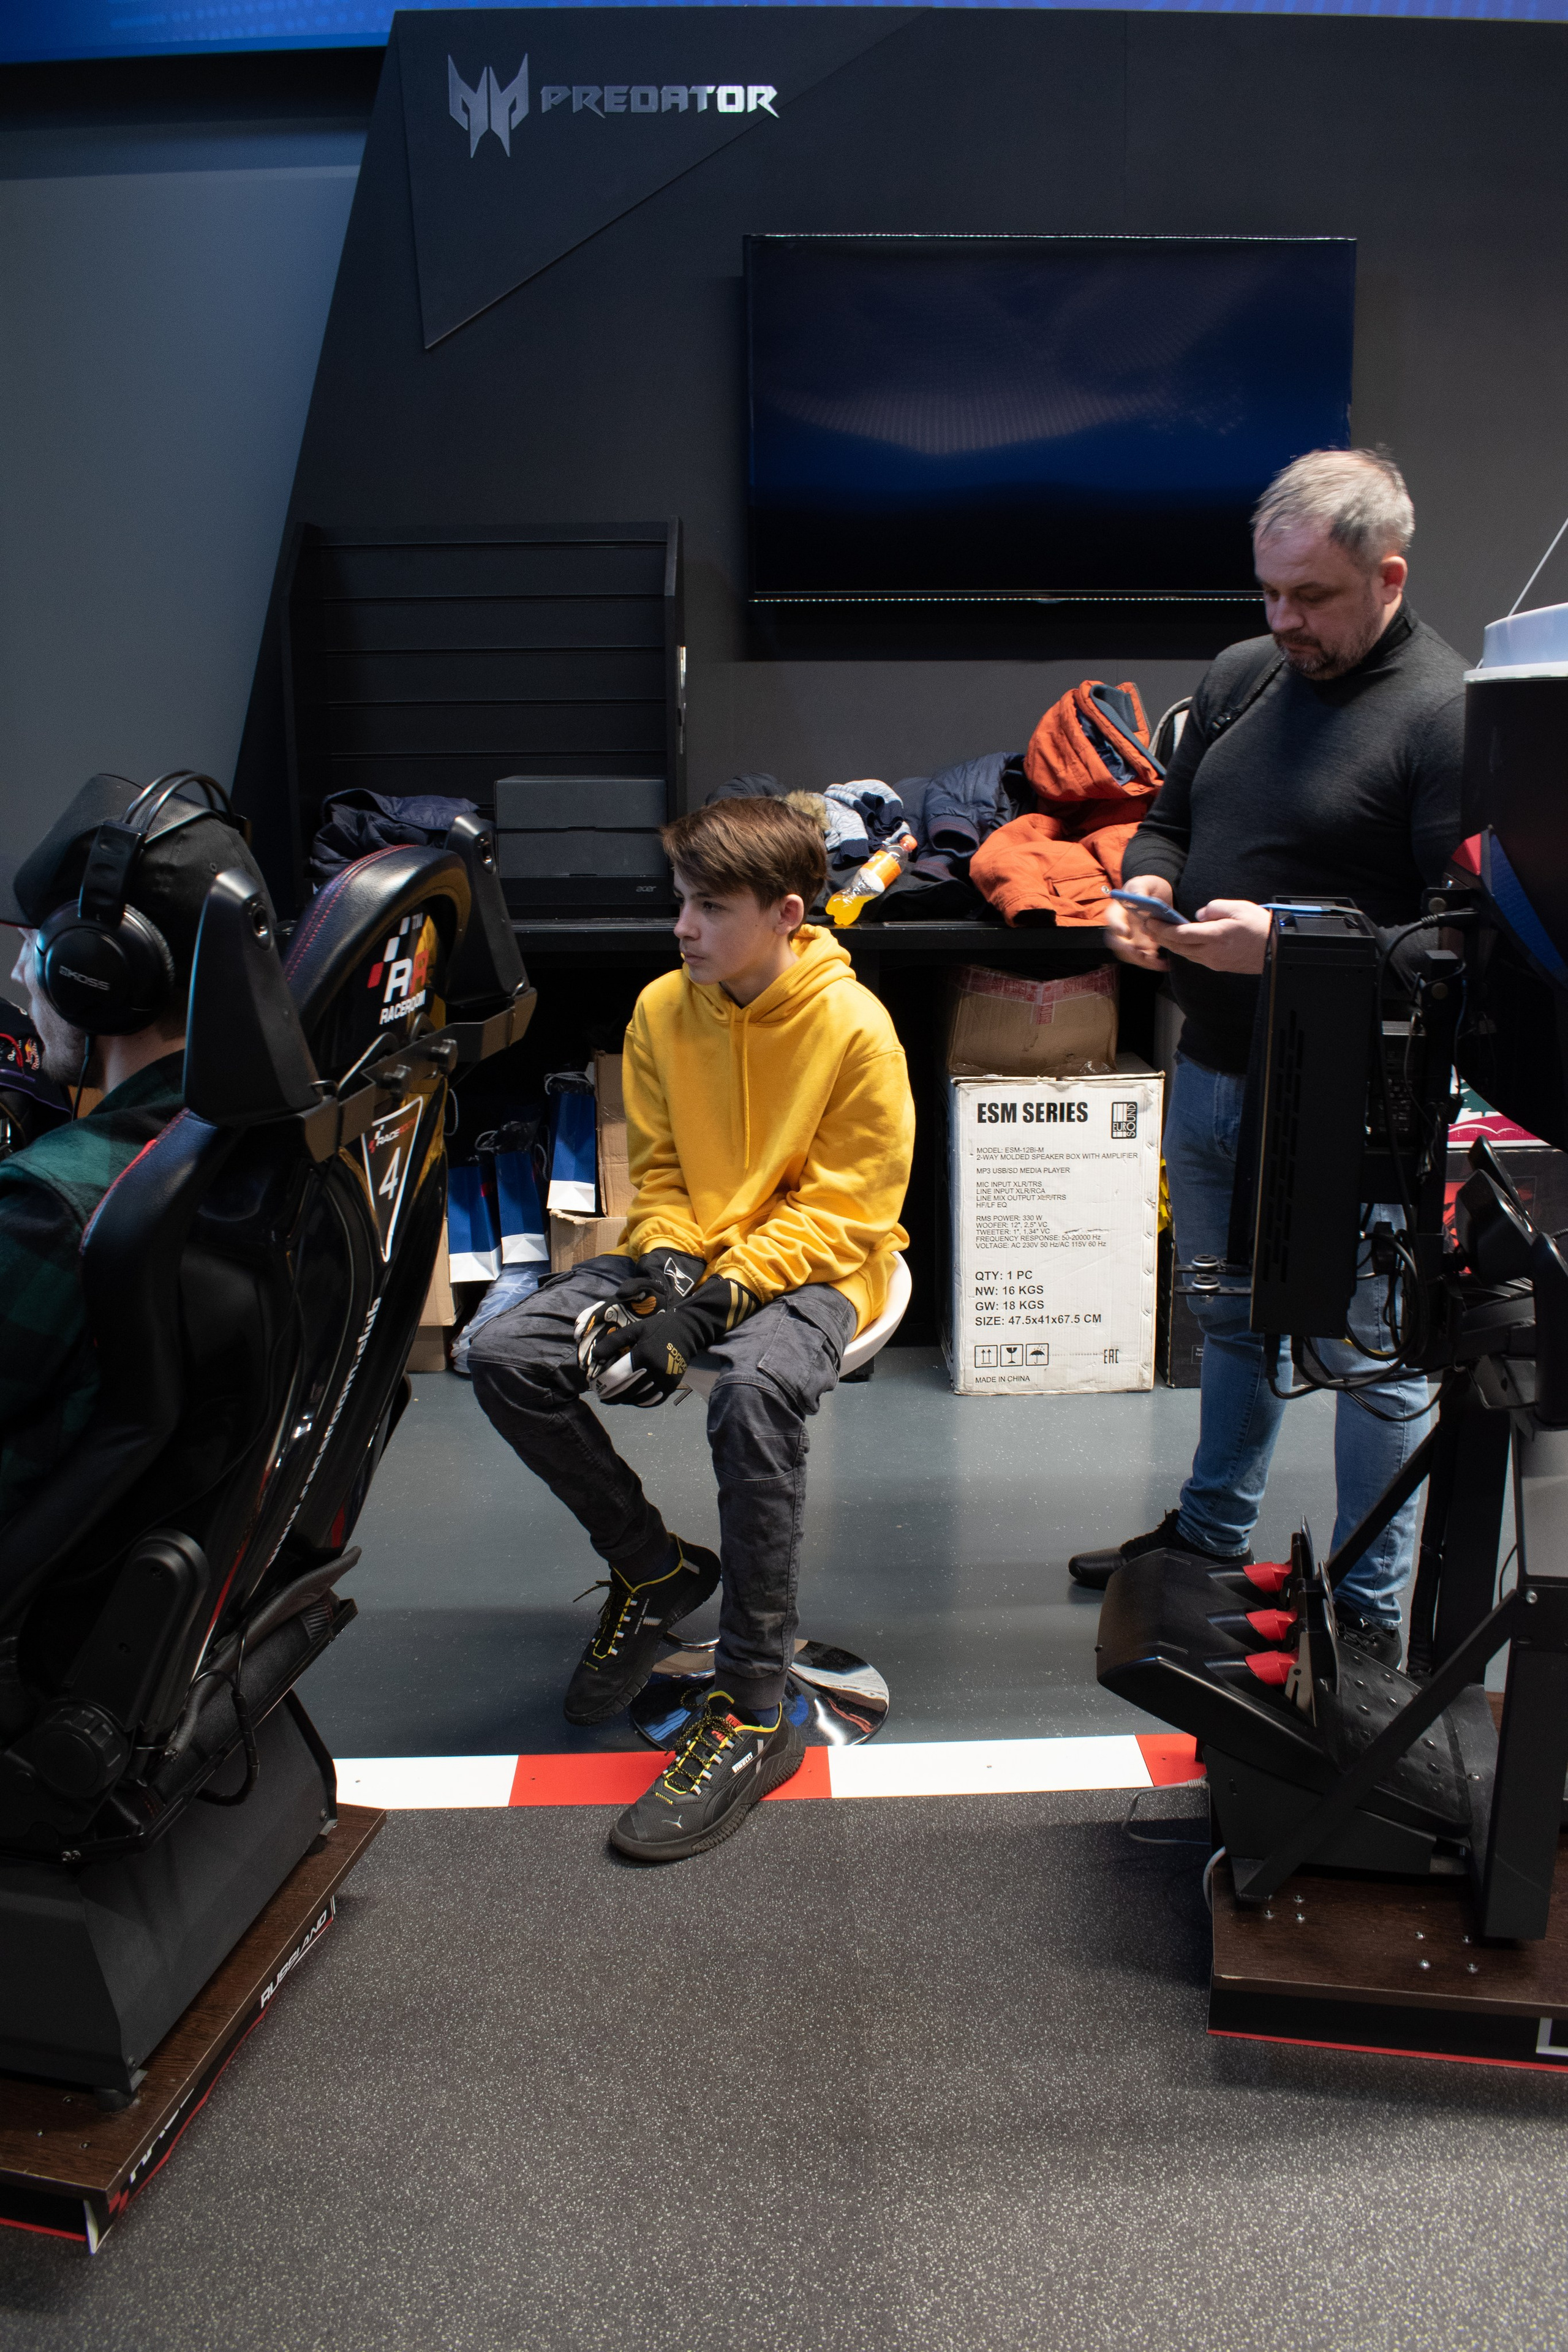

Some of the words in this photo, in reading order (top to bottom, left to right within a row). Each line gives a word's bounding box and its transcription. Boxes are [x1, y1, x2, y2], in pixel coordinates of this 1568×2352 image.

[540, 85, 780, 119] PREDATOR
[69, 969, 111, 991] KOSS
[379, 989, 426, 1025] RACEROOM
[978, 1102, 1017, 1123] ESM
[1023, 1102, 1088, 1123] SERIES
[379, 1147, 401, 1200] 4
[975, 1272, 1002, 1281] QTY:
[1008, 1271, 1012, 1280] 1
[1017, 1270, 1032, 1280] PC
[975, 1287, 998, 1295] NW:
[1003, 1286, 1015, 1295] 16
[1019, 1286, 1044, 1294] KGS
[975, 1302, 998, 1311] GW:
[1003, 1301, 1015, 1310] 18
[1020, 1300, 1044, 1309] KGS
[975, 1317, 1004, 1325] SIZE:
[1009, 1315, 1080, 1324] 47.5x41x67.5
[666, 1342, 687, 1371] adidas
[1104, 1349, 1119, 1363] EAC
[261, 1909, 327, 2009] RUSSLAND
